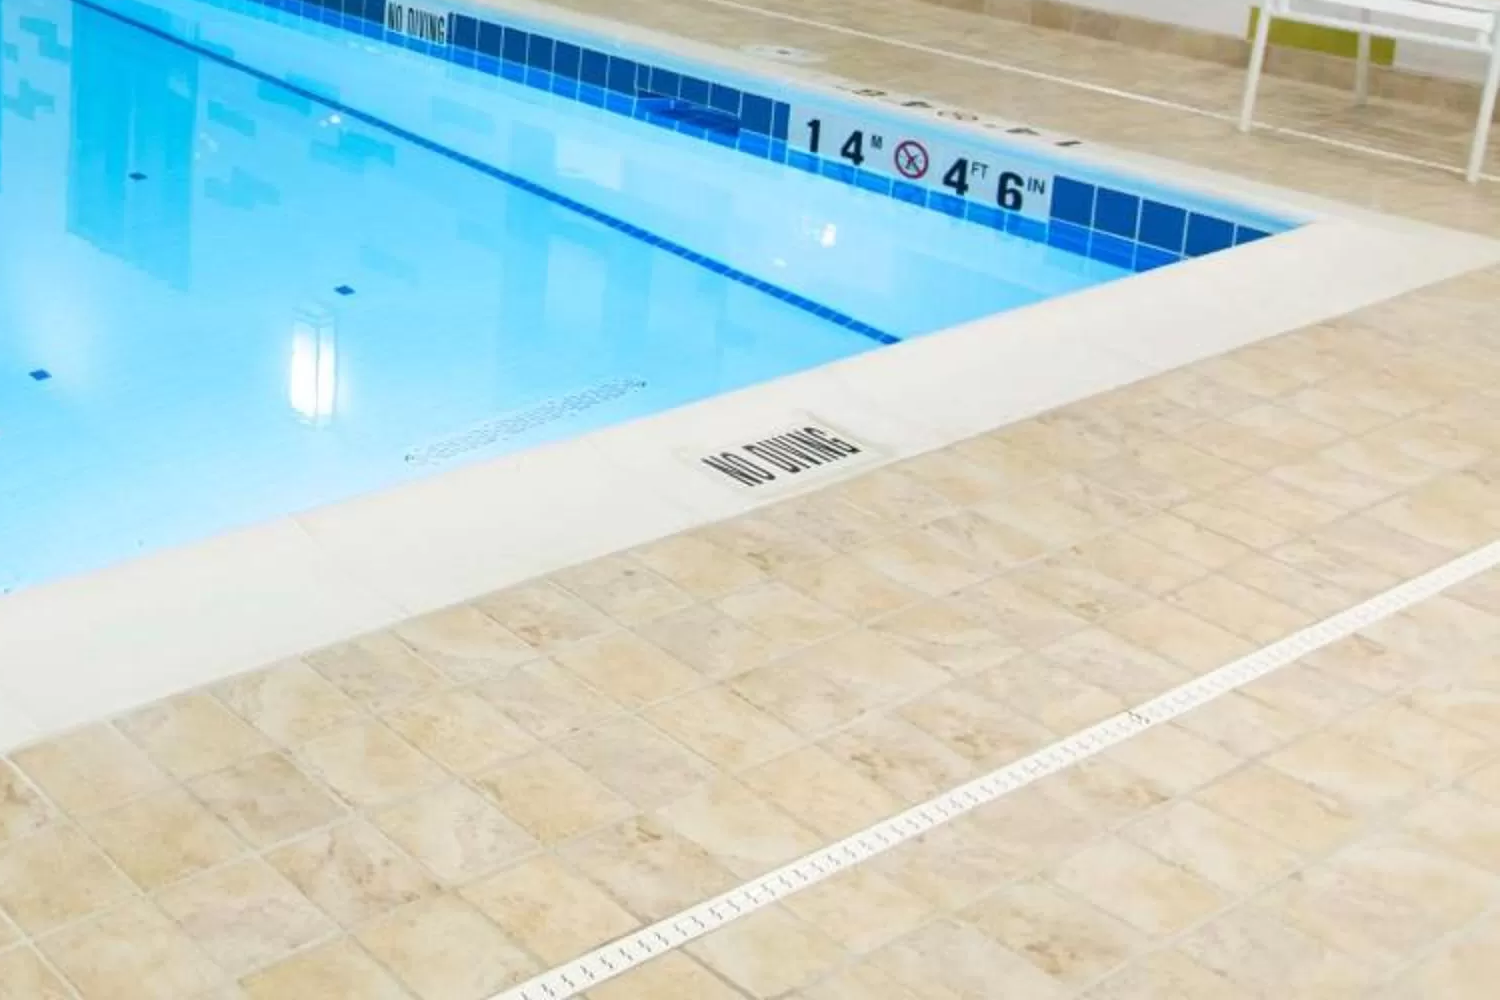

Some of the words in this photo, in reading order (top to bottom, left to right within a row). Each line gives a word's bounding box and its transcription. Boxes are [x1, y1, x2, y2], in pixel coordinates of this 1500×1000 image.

[387, 2, 403, 32] NO
[407, 7, 445, 45] DIVING
[700, 451, 776, 487] NO
[740, 427, 863, 475] DIVING
